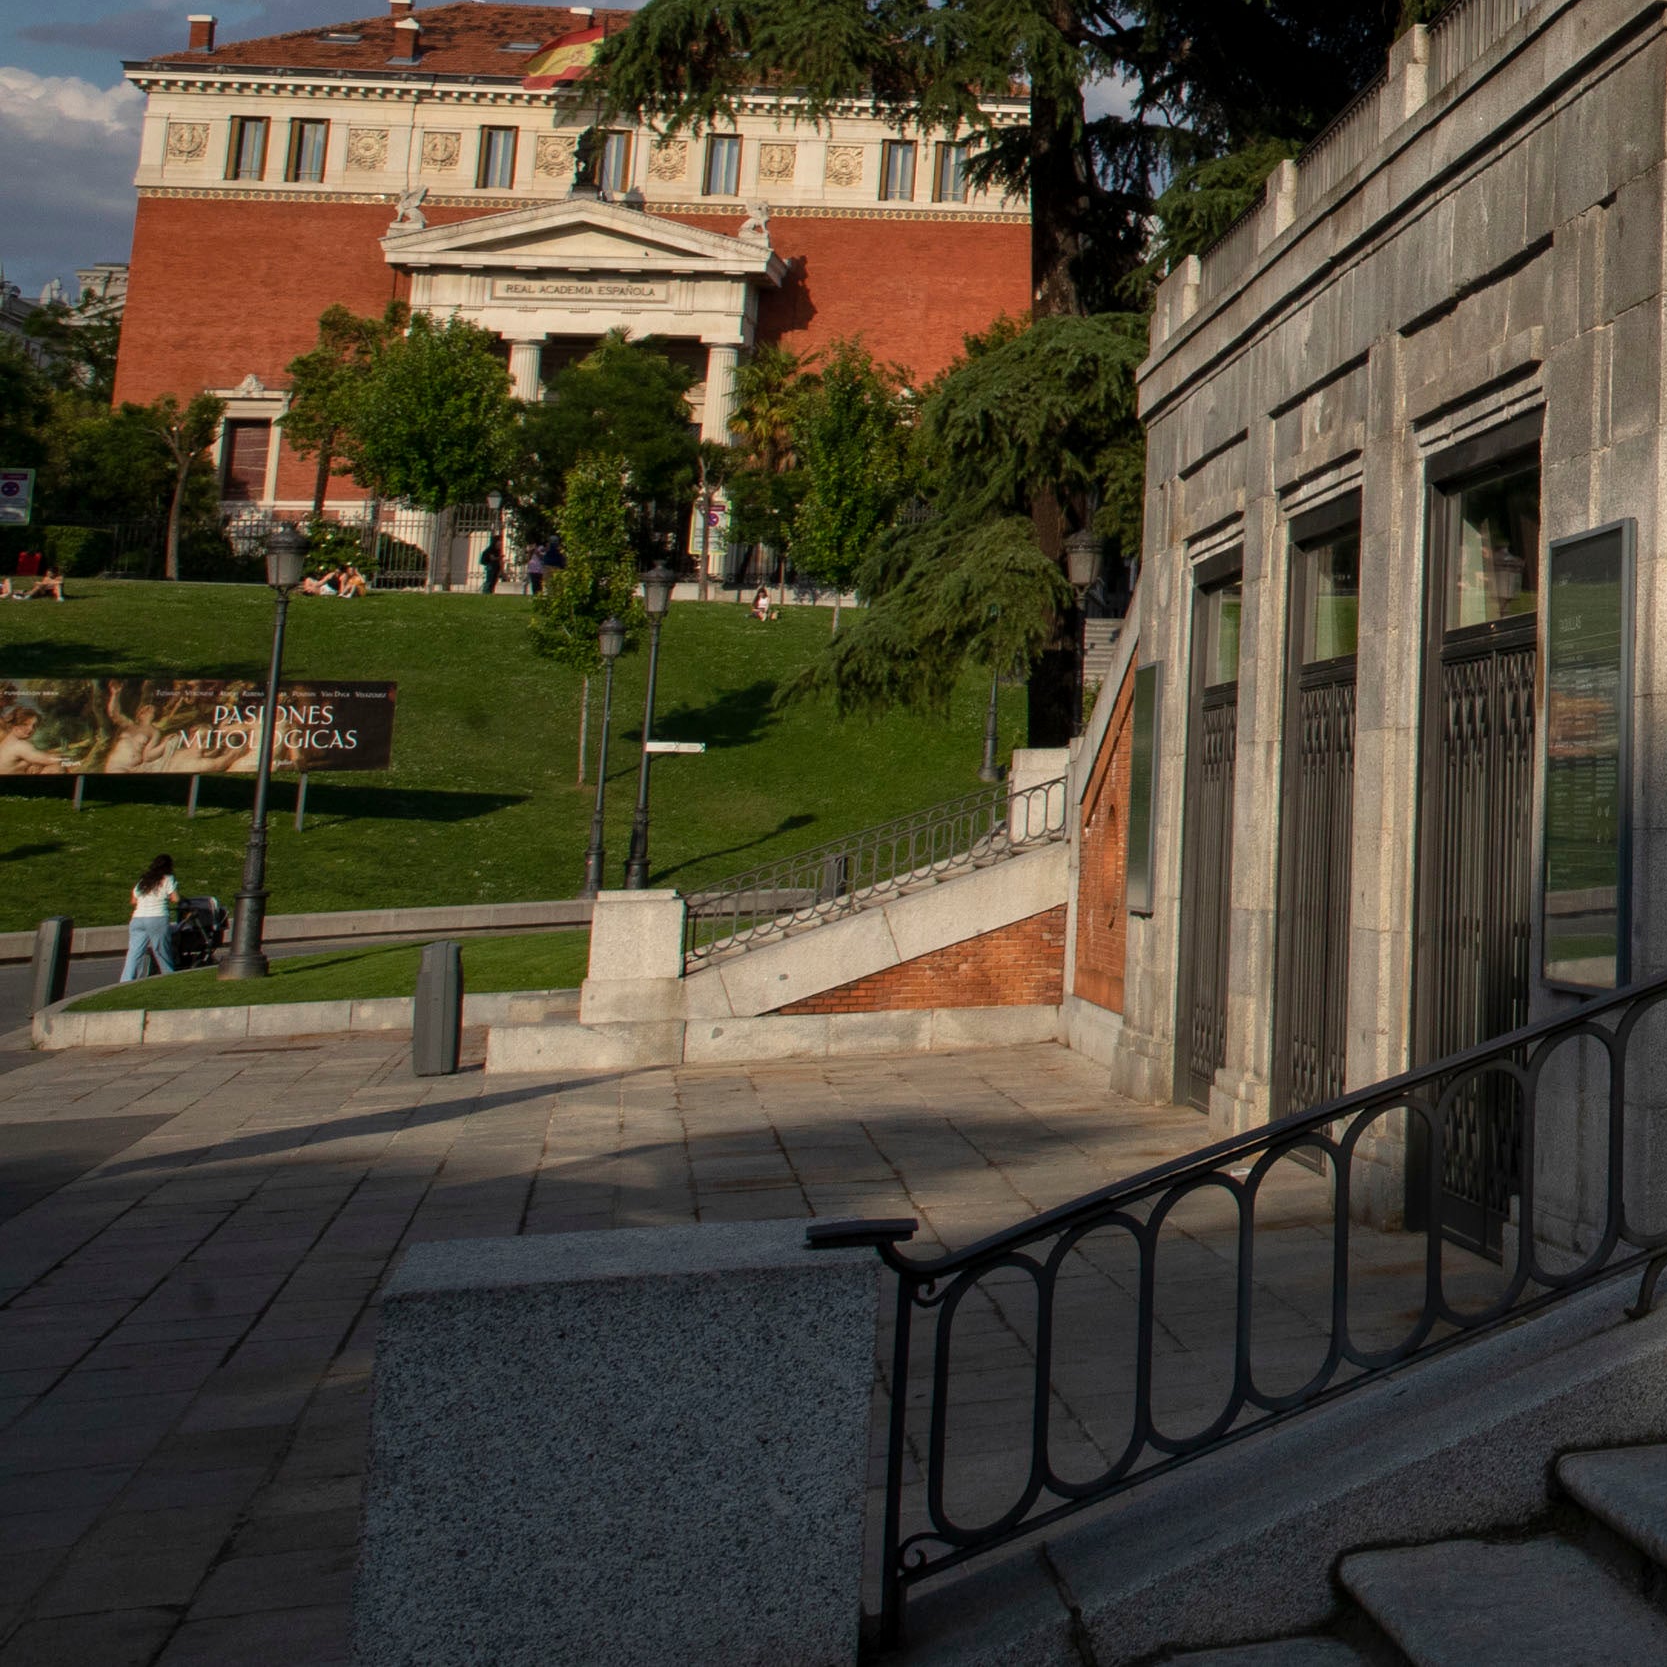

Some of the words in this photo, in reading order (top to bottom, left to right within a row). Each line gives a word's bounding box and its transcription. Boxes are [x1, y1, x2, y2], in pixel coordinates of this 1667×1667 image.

[505, 284, 535, 294] REAL
[539, 285, 594, 295] ACADEMIA
[598, 285, 655, 296] ESPAÑOLA
